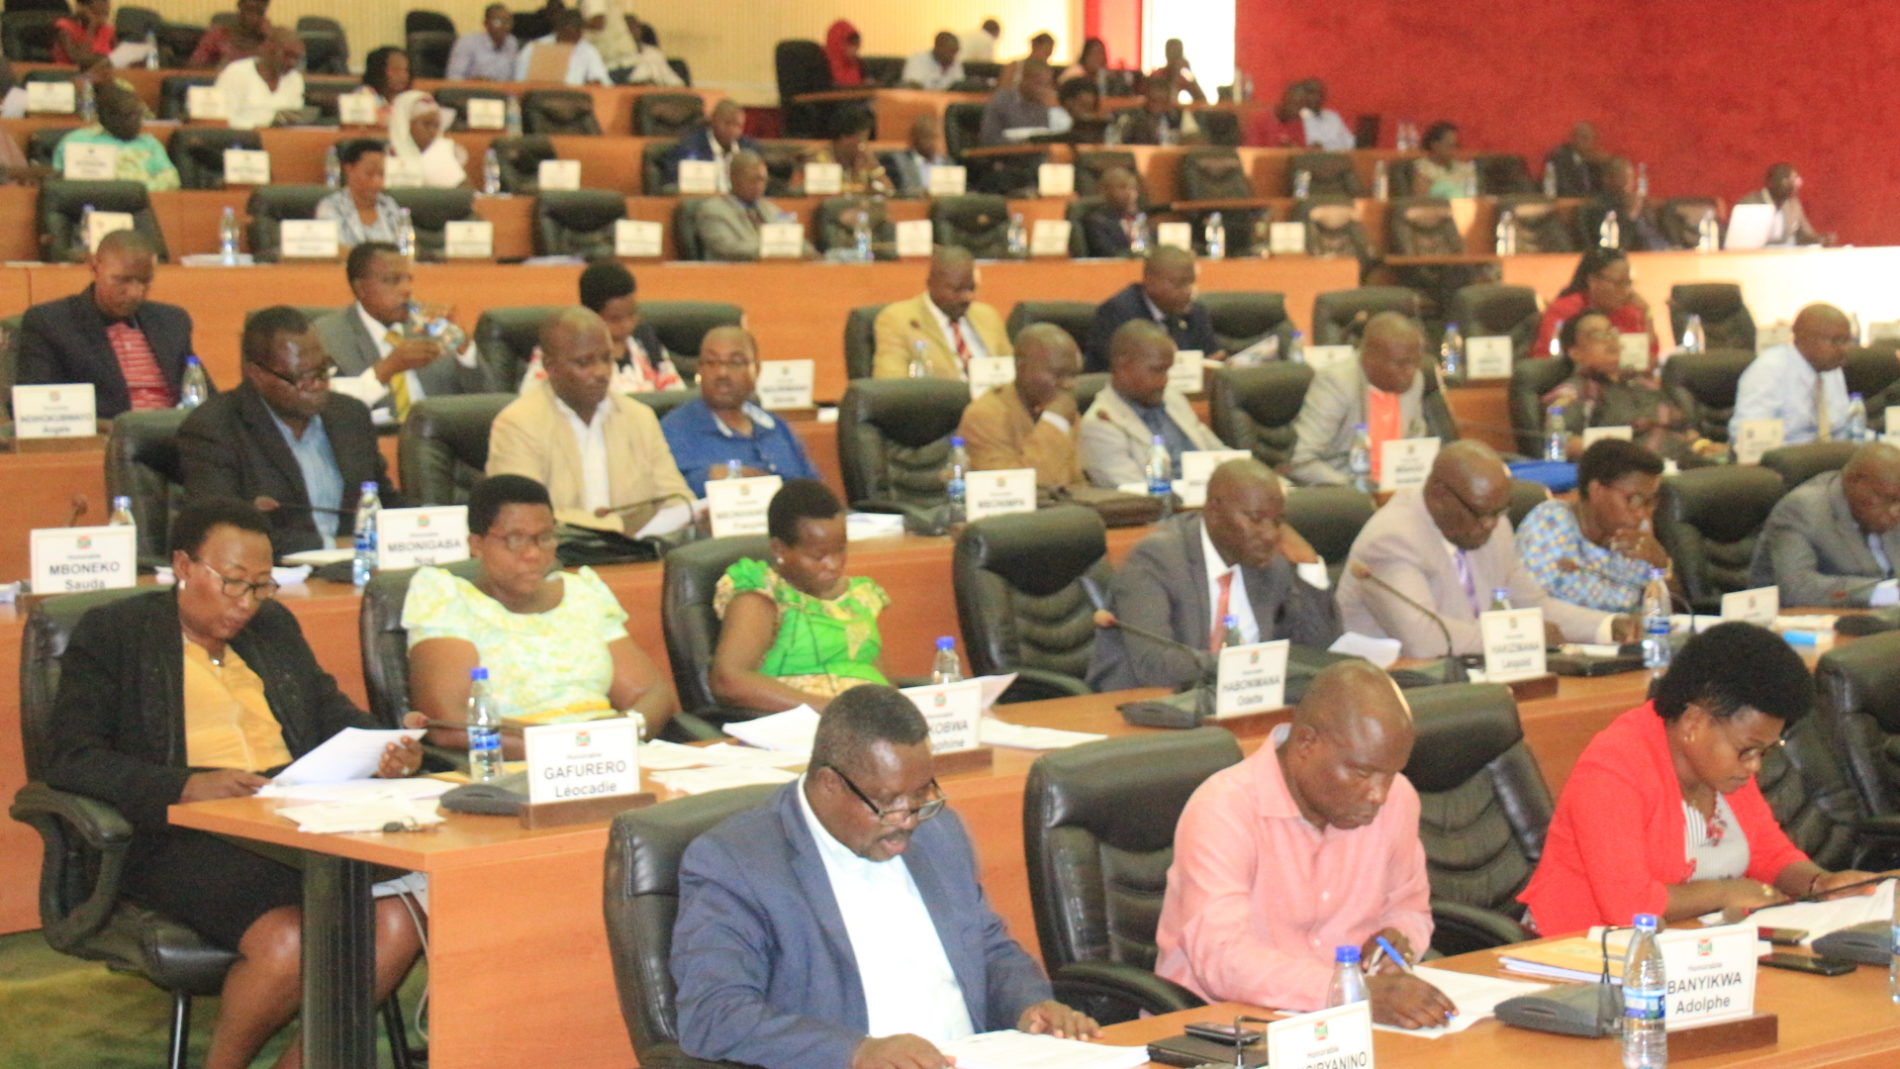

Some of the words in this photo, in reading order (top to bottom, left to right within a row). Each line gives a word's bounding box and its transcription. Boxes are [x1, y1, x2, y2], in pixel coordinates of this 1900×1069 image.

[49, 560, 121, 576] MBONEKO
[65, 578, 106, 591] Sauda
[928, 719, 969, 734] KOBWA
[544, 759, 627, 781] GAFURERO
[555, 780, 618, 799] Léocadie
[1667, 971, 1743, 995] BANYIKWA
[1675, 995, 1732, 1015] Adolphe
